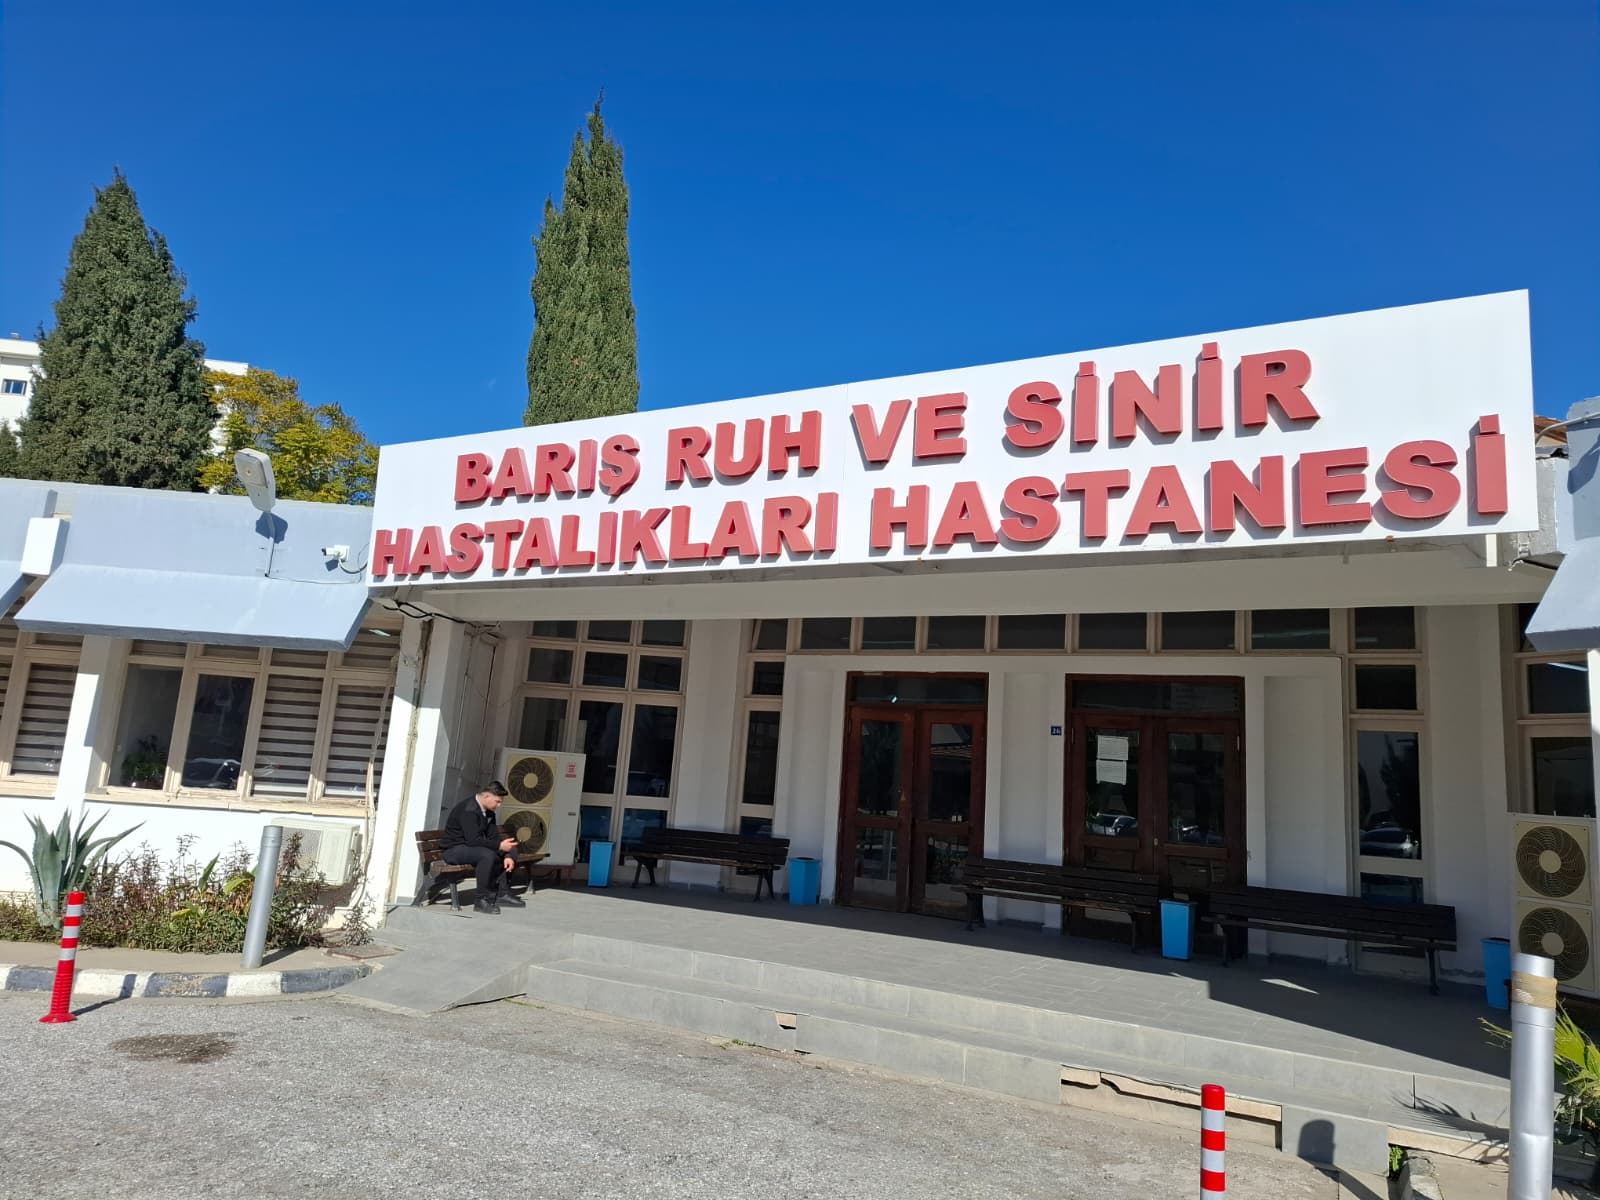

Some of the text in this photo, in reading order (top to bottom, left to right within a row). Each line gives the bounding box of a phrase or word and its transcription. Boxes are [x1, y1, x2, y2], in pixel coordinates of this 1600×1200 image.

[372, 414, 1508, 577] HASTALIKLARI HASTANESİ
[455, 342, 1319, 504] BARIŞ RUH VE SİNİR
